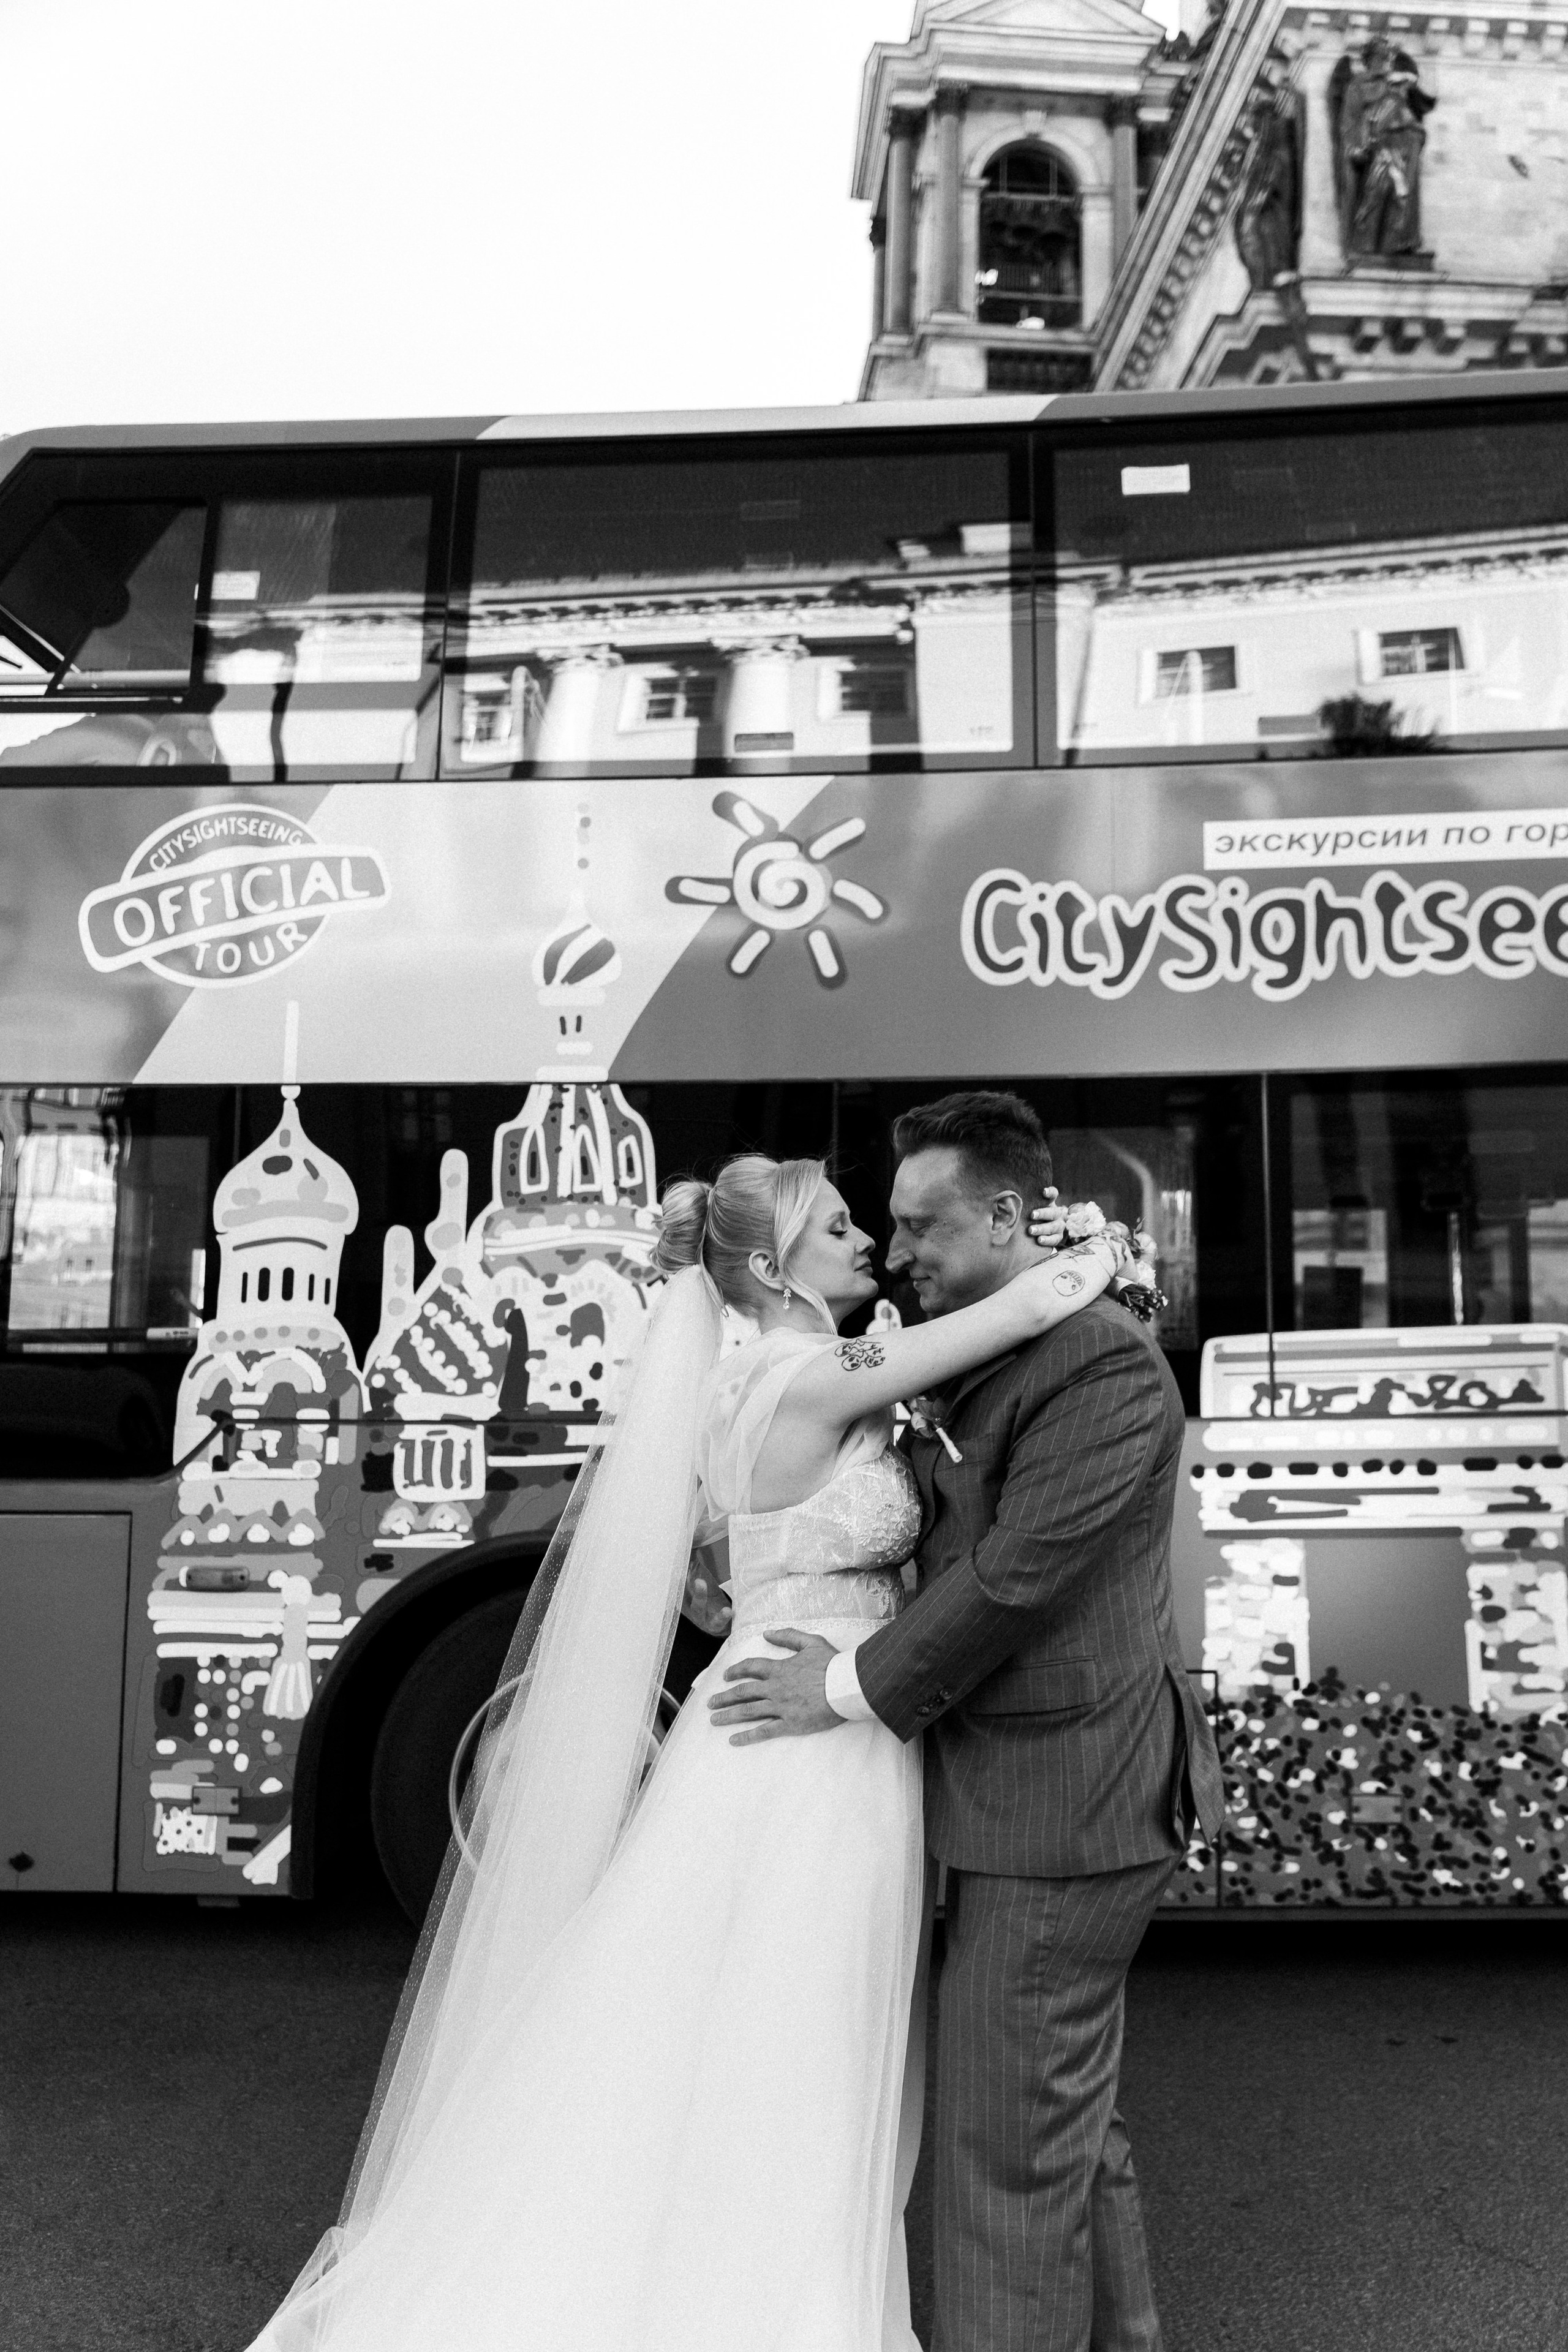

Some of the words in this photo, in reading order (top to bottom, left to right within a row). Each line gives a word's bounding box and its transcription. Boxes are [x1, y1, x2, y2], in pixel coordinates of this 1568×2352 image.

[149, 816, 303, 872] CITYSIGHTSEEING
[1215, 828, 1428, 856] экскурсии
[1444, 826, 1490, 845] по
[1506, 823, 1568, 848] гор
[113, 858, 371, 947] OFFICIAL
[194, 921, 308, 973] TOUR
